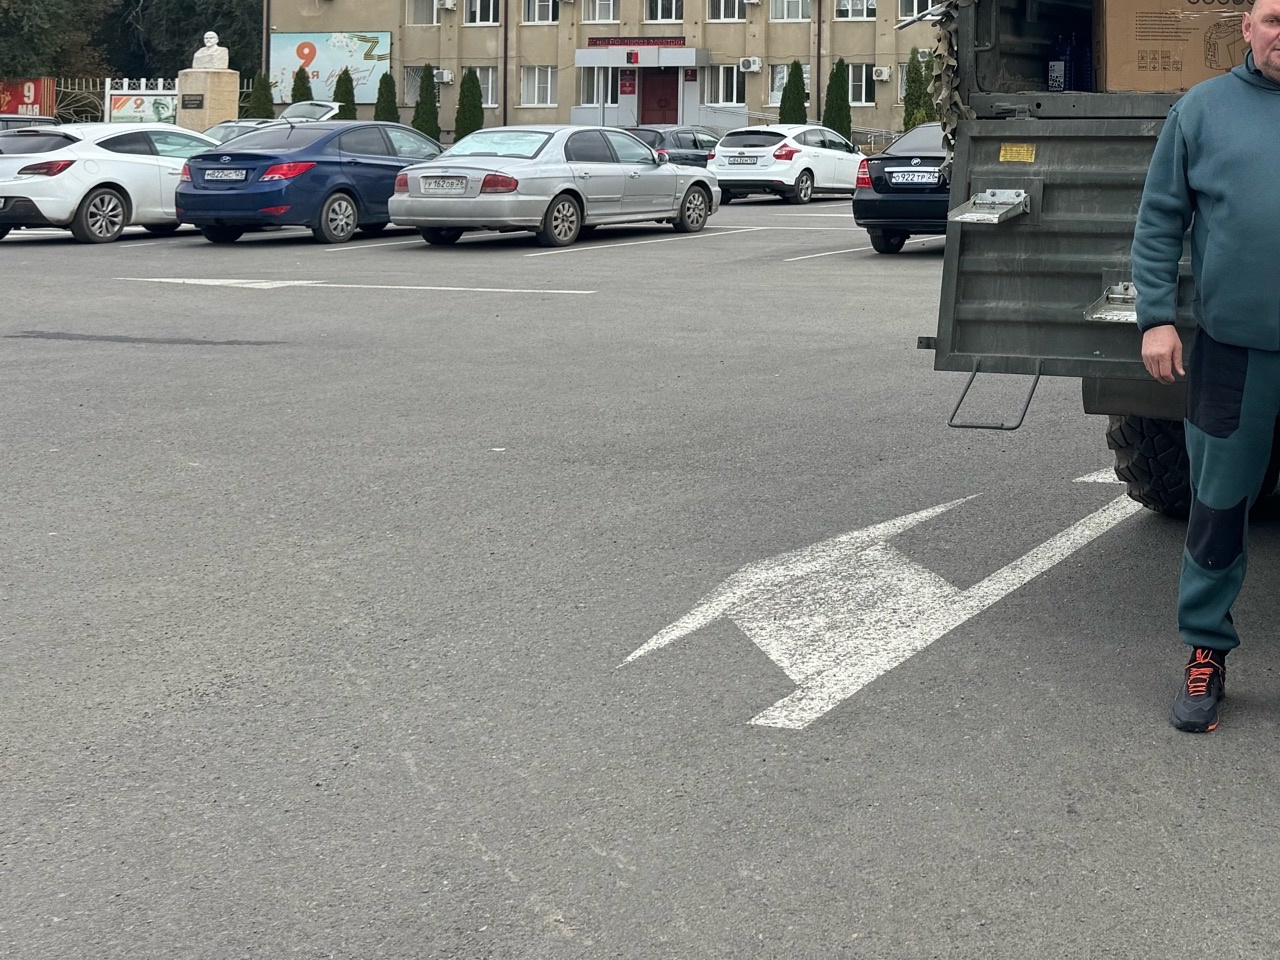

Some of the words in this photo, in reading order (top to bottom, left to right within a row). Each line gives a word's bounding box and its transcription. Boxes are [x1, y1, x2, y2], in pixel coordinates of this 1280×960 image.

[296, 41, 317, 68] 9
[23, 81, 35, 104] 9
[18, 105, 40, 116] МАЯ
[133, 97, 145, 110] 9
